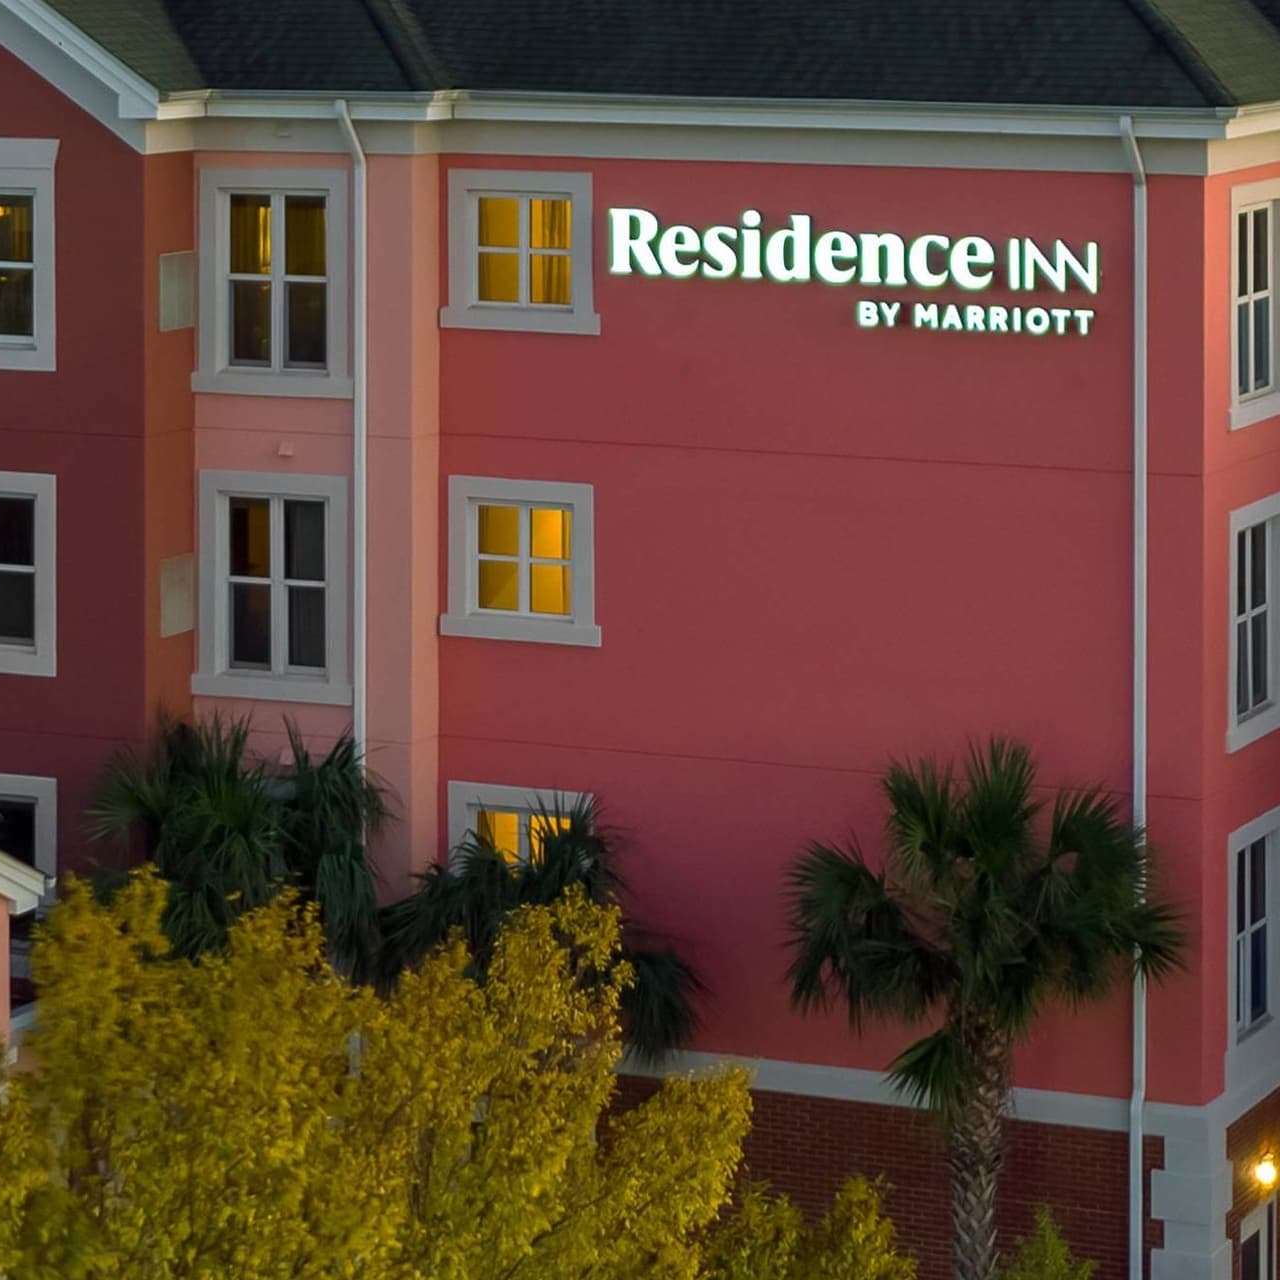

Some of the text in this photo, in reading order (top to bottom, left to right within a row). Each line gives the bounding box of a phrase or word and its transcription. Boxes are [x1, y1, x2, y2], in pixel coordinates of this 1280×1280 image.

[607, 207, 1099, 295] Residence INN
[857, 300, 1094, 336] BY MARRIOTT
